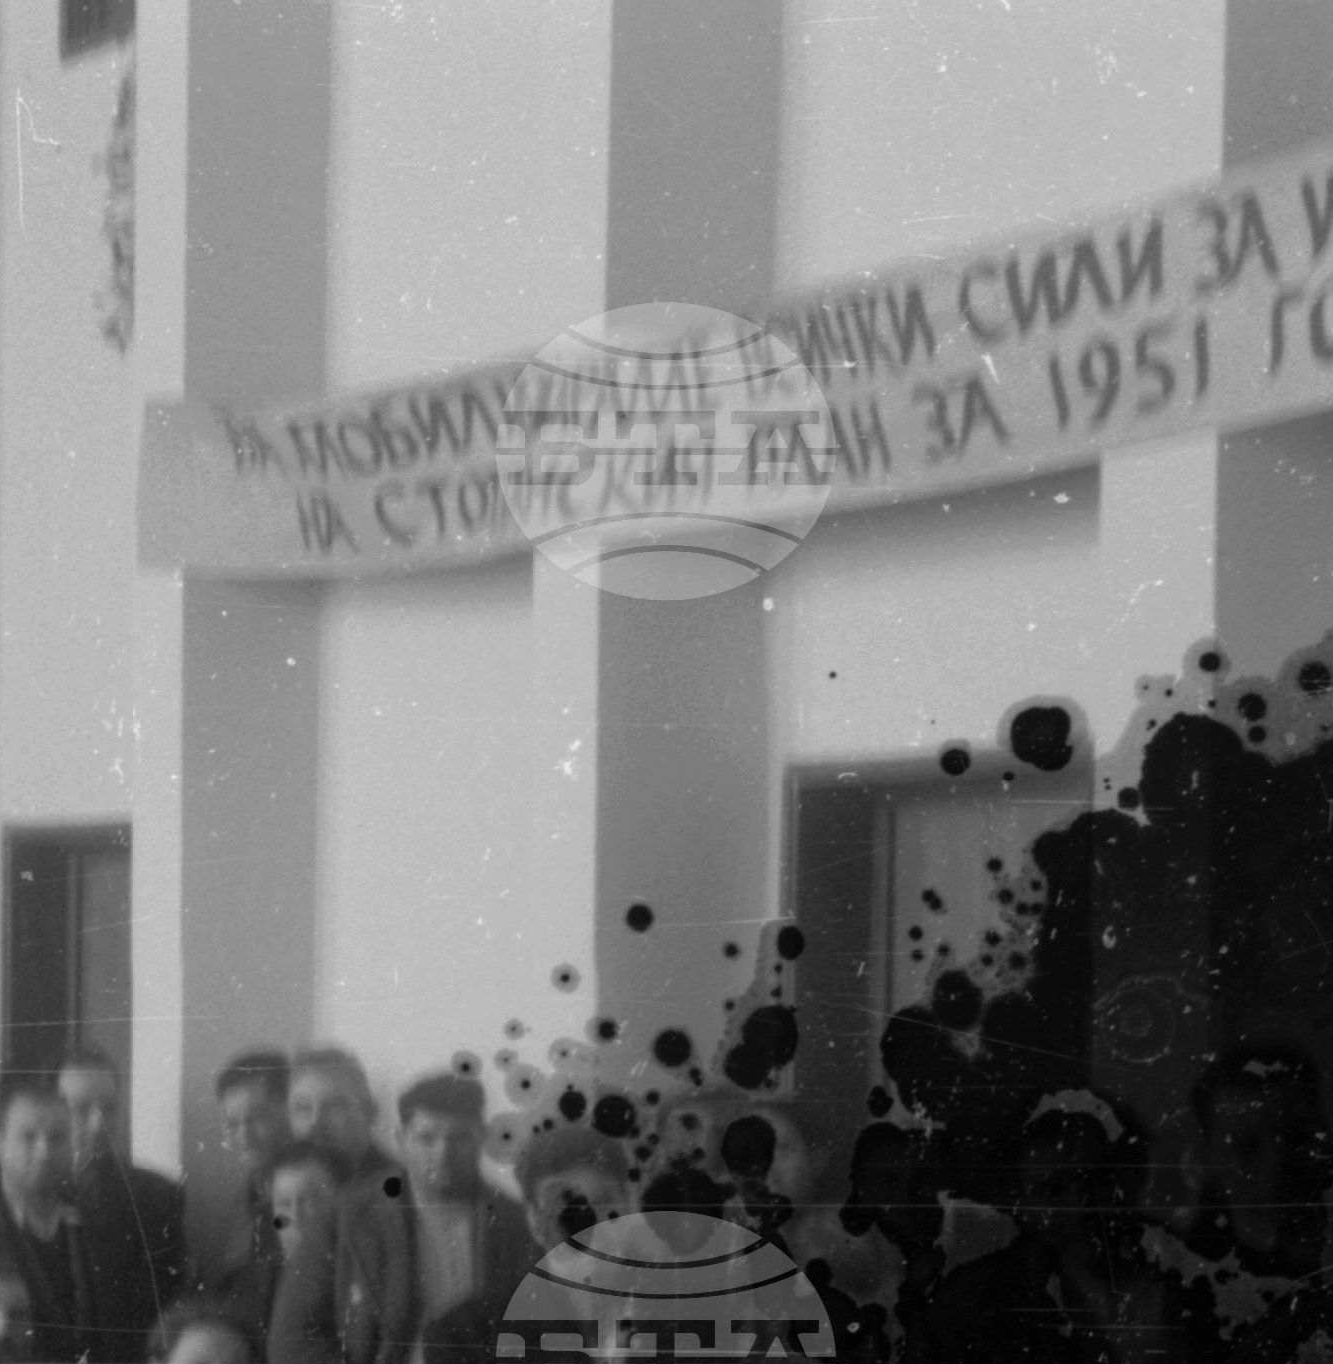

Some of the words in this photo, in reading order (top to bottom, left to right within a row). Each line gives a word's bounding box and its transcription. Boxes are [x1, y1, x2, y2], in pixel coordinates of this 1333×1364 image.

[733, 284, 937, 402] ВСИЧКИ
[958, 210, 1164, 343] СИЛИ
[1193, 190, 1281, 300] ЗА
[296, 487, 361, 554] НА
[743, 400, 893, 494] ПЛАН
[911, 375, 1013, 466] ЗА
[1047, 312, 1212, 434] 1951
